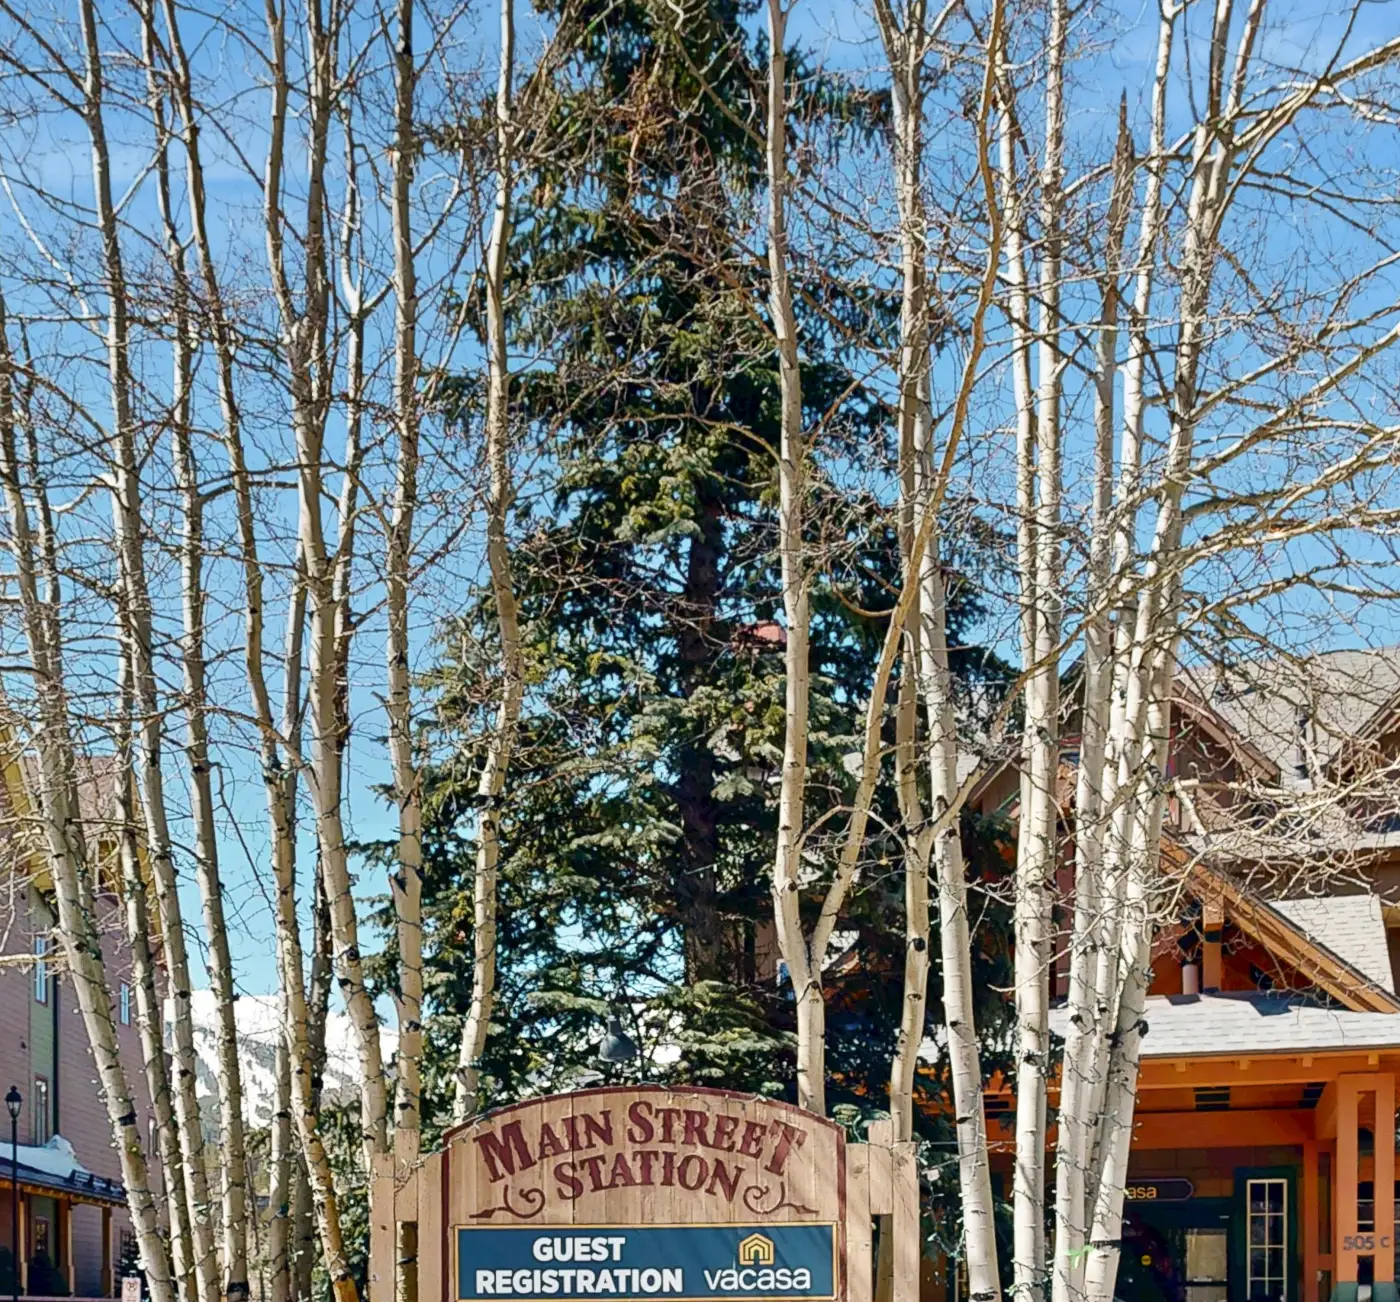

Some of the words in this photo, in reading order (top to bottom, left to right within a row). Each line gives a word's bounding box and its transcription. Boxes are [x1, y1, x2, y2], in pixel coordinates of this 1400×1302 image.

[473, 1110, 614, 1183] MAIN
[627, 1100, 808, 1177] STREET
[554, 1150, 745, 1202] STATION
[532, 1237, 625, 1261] GUEST
[1343, 1235, 1375, 1250] 505
[475, 1268, 683, 1294] REGISTRATION
[703, 1267, 811, 1290] vacasa
